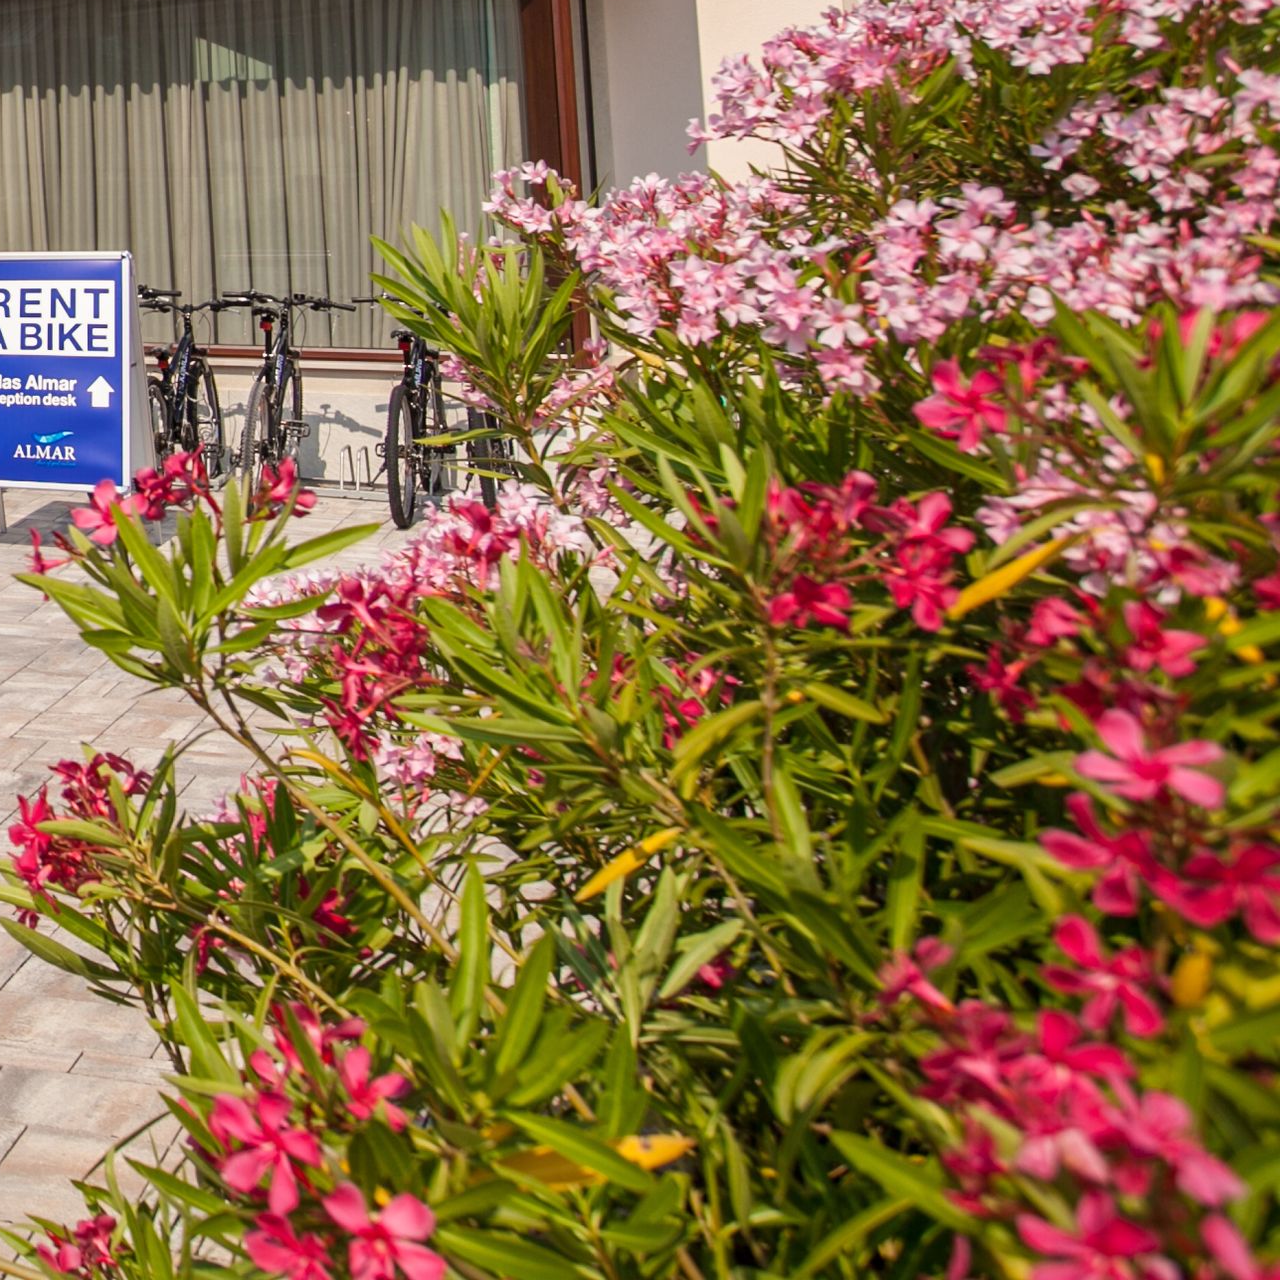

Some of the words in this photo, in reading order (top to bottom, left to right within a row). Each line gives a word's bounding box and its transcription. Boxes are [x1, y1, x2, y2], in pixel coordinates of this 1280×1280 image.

[20, 323, 109, 352] BIKE
[25, 374, 77, 391] Almar
[42, 393, 77, 407] desk
[13, 443, 76, 461] ALMAR
